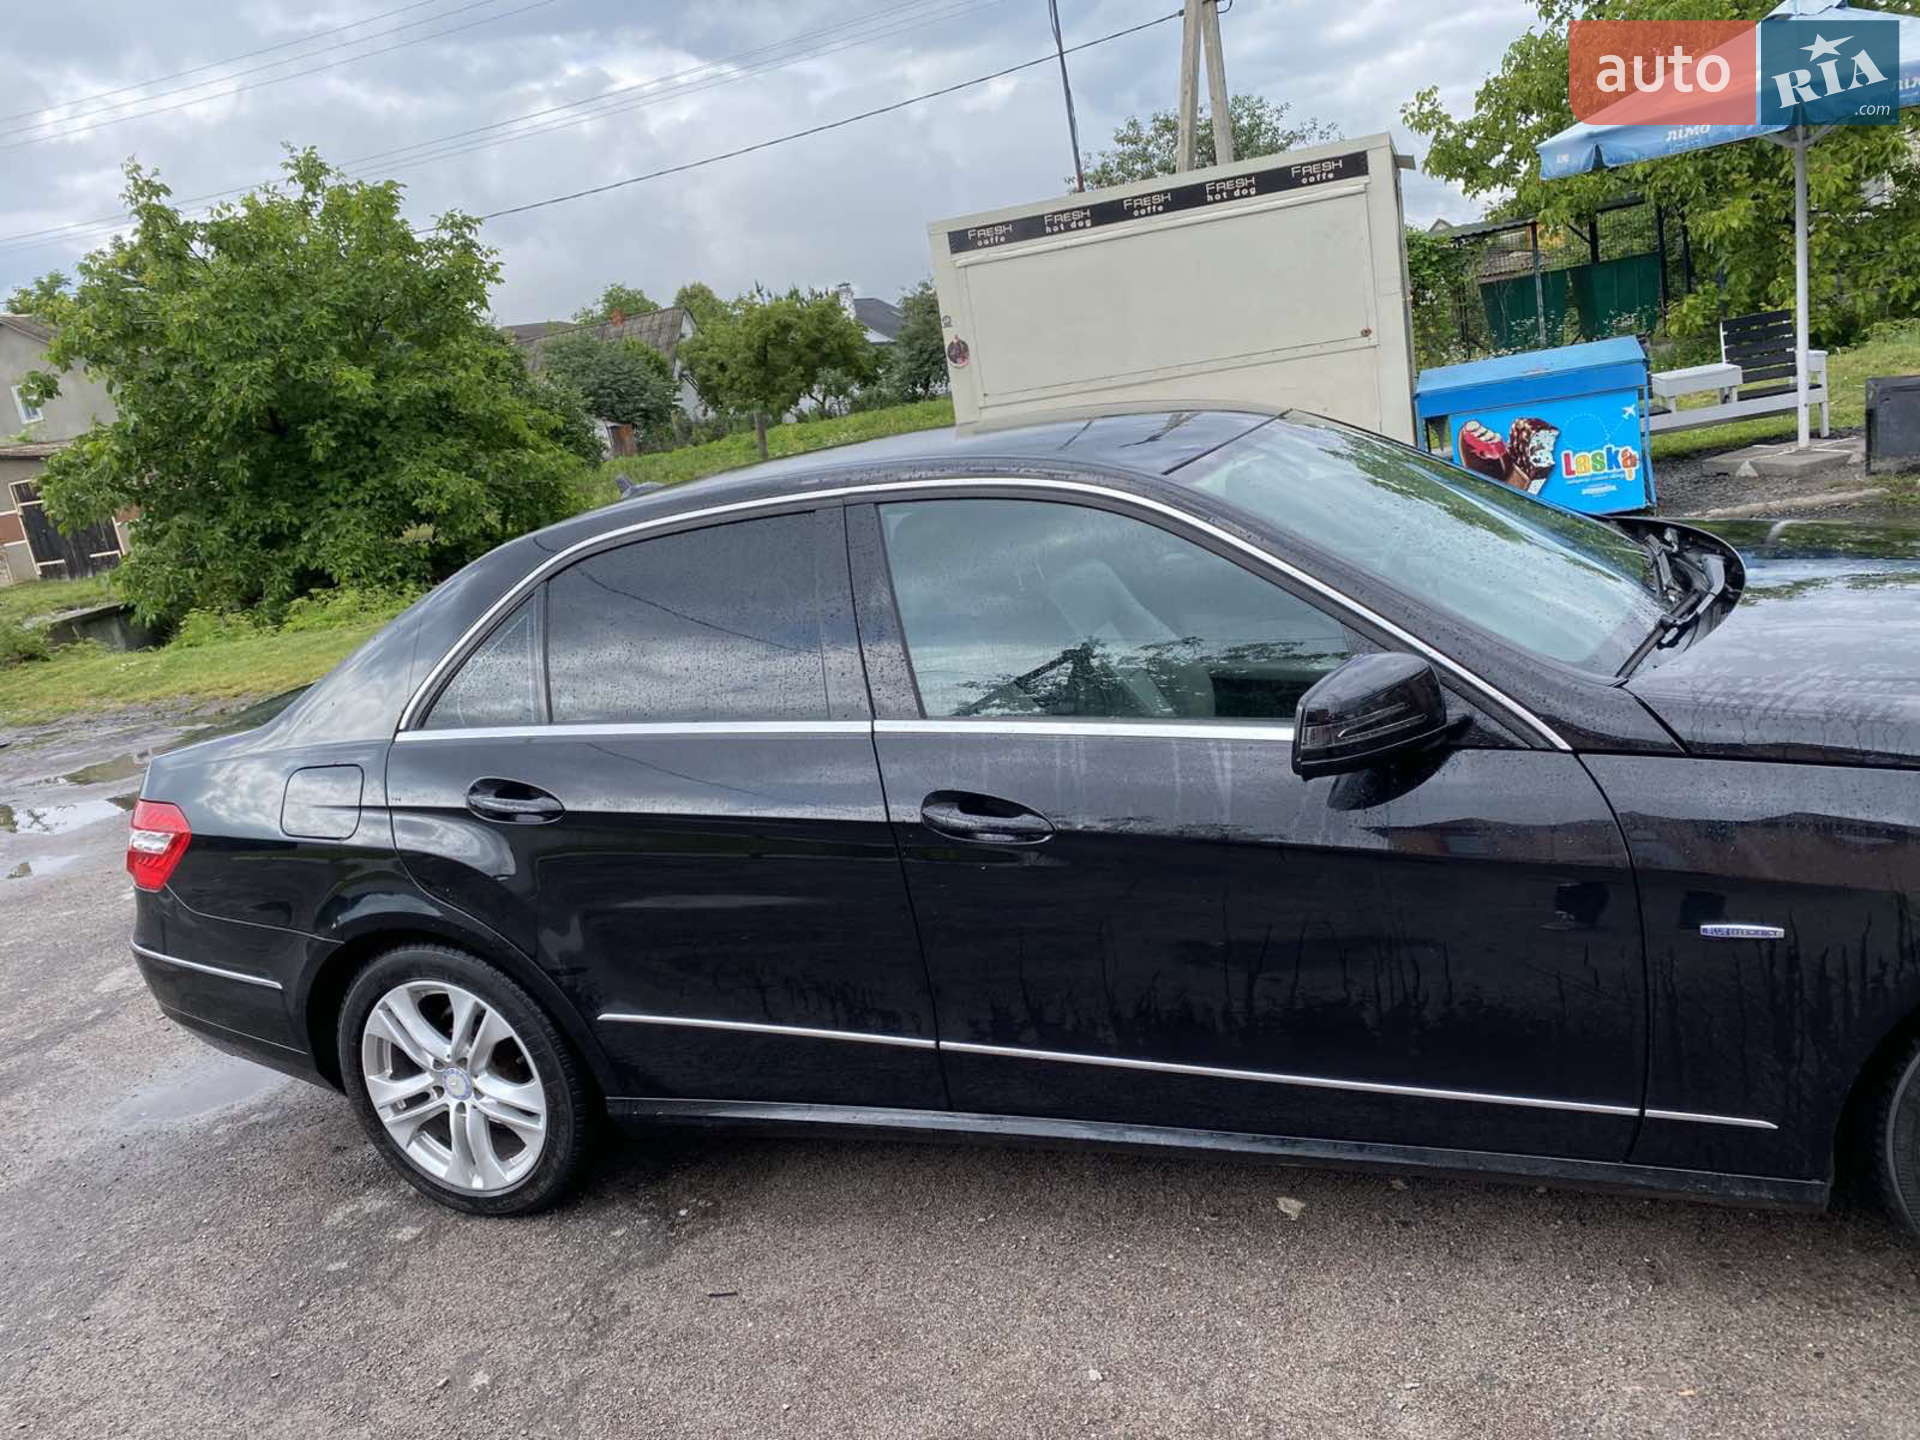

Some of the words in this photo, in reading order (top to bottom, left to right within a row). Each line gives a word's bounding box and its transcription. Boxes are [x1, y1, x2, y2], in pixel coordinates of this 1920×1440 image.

[1291, 159, 1343, 178] FRESH
[1205, 176, 1256, 195] FRESH
[1206, 191, 1227, 202] hot
[1233, 186, 1256, 198] dog
[1123, 192, 1171, 211] FRESH
[1044, 208, 1091, 226] FRESH
[1045, 222, 1065, 234] hot
[1070, 218, 1092, 230] dog
[967, 223, 1013, 241] FRESH
[1562, 445, 1638, 480] Laska
